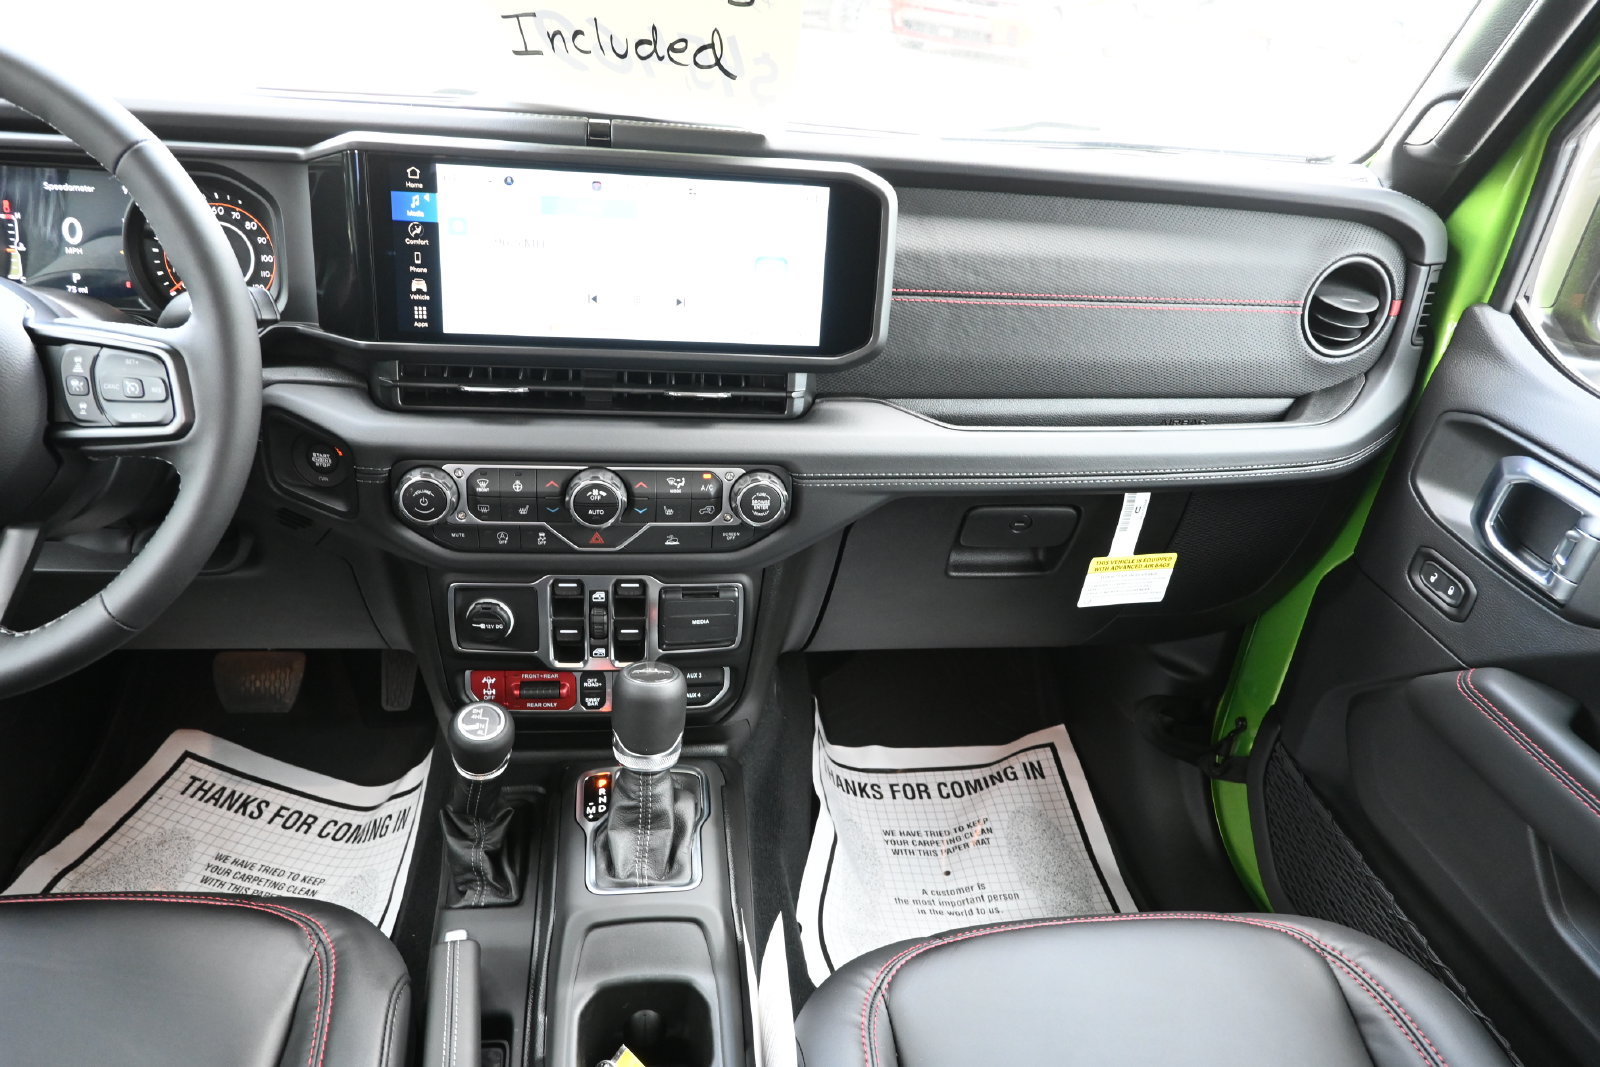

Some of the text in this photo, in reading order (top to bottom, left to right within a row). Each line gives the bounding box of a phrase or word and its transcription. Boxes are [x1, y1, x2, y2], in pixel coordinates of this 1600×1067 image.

[501, 12, 738, 81] Included
[43, 181, 96, 193] Speedometer
[405, 181, 423, 189] Home
[231, 211, 241, 220] 70
[406, 210, 425, 218] Media
[61, 216, 83, 245] 0
[244, 221, 258, 231] 80
[256, 236, 267, 244] 90
[405, 237, 430, 246] Comfort
[64, 246, 84, 255] MPH
[260, 254, 274, 263] 100
[260, 270, 271, 278] 110
[409, 265, 428, 274] Phone
[71, 272, 82, 284] P
[78, 286, 89, 294] mi
[409, 293, 430, 301] Vehicle
[413, 321, 429, 329] Apps
[700, 484, 714, 493] A/C
[888, 782, 932, 801] FOR
[937, 765, 1019, 799] COMING
[1022, 759, 1046, 781] IN
[180, 775, 412, 845] THANKS FOR COMING IN
[586, 806, 596, 814] M
[882, 817, 989, 838] WE HAVE TRIED TO KEEP
[911, 835, 962, 847] CARPETING
[891, 837, 991, 857] WITH THIS PAPER MAT
[214, 852, 326, 887] WE HAVE TRIED TO KEEP
[200, 875, 227, 889] WITH
[227, 882, 251, 896] THIS
[205, 863, 319, 898] YOUR CARPETING CLEAN
[921, 882, 986, 897] A customer is
[894, 892, 1020, 908] the most important person
[917, 906, 1004, 917] in the world to us.
